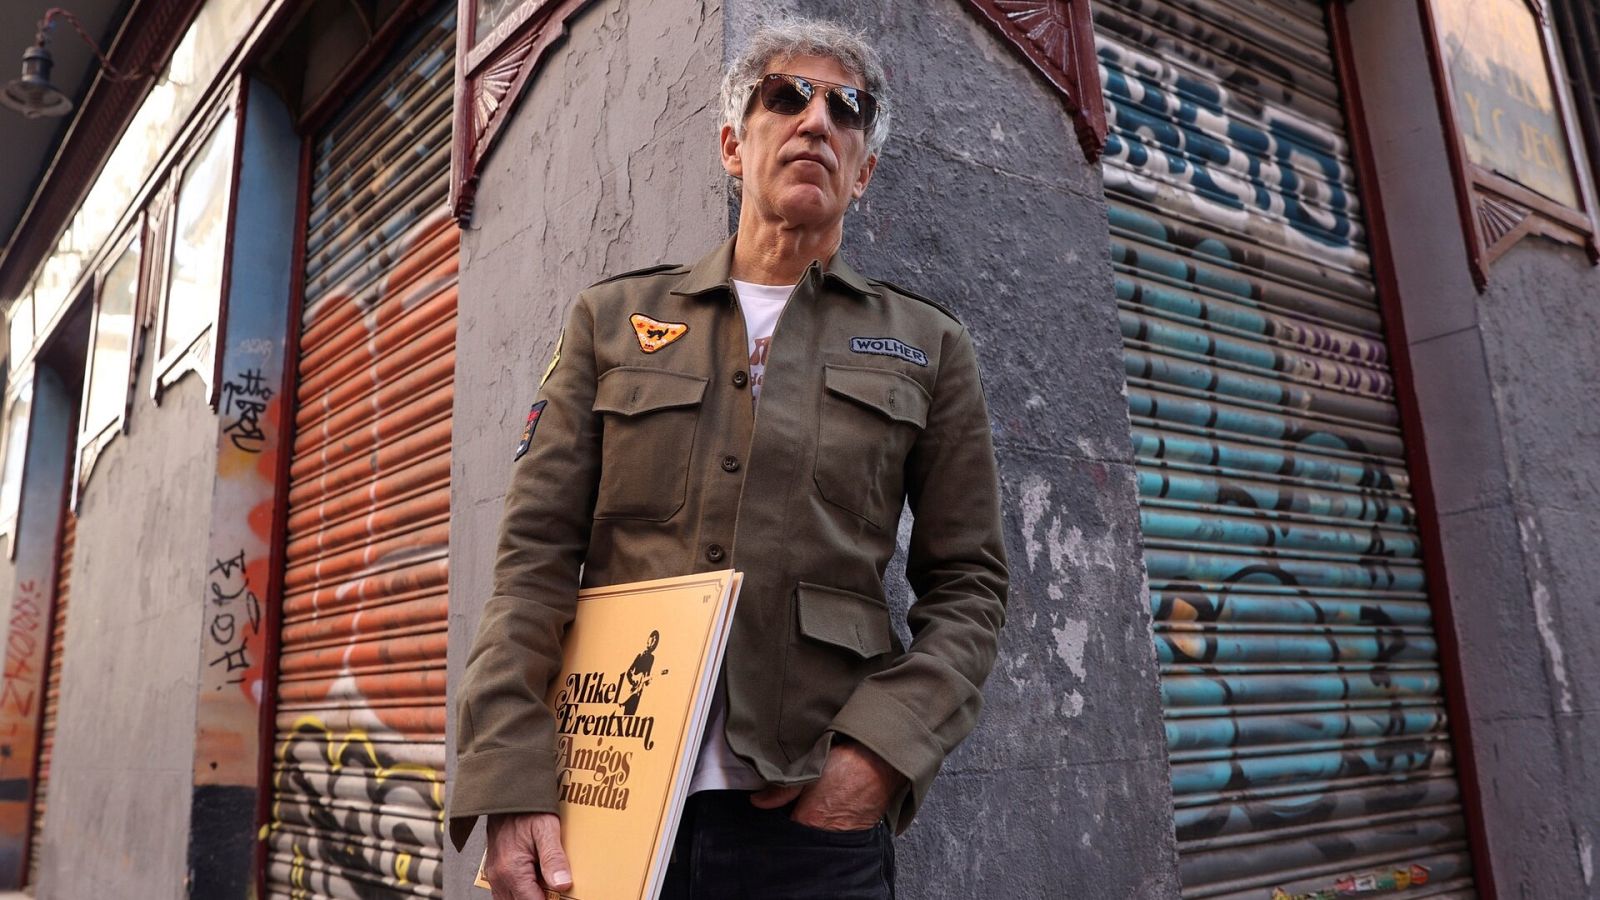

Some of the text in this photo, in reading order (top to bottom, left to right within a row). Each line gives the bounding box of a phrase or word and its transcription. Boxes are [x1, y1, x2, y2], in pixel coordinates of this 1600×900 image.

[857, 340, 922, 361] WOLHER
[555, 672, 626, 711] Mikel
[557, 703, 655, 751] Erentxun
[556, 736, 633, 786] Amigos
[556, 769, 630, 811] Guardia
